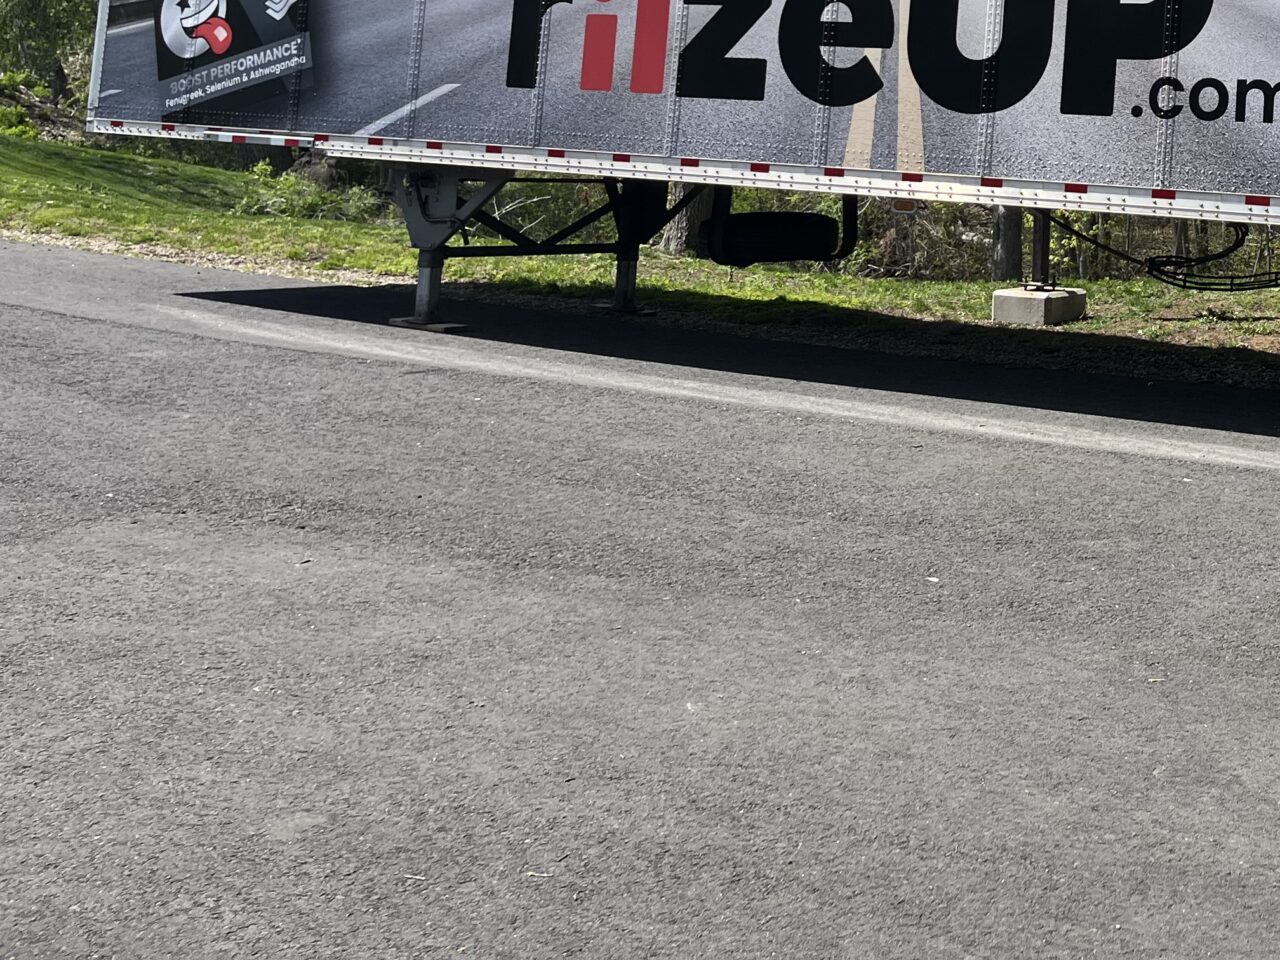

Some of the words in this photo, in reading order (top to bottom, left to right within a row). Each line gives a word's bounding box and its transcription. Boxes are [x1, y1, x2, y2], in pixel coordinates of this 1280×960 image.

[165, 90, 205, 109] Fenugreek,
[206, 76, 241, 94] Selenium
[242, 71, 249, 82] &
[250, 55, 306, 81] Ashwagandha
[170, 71, 209, 94] BOOST
